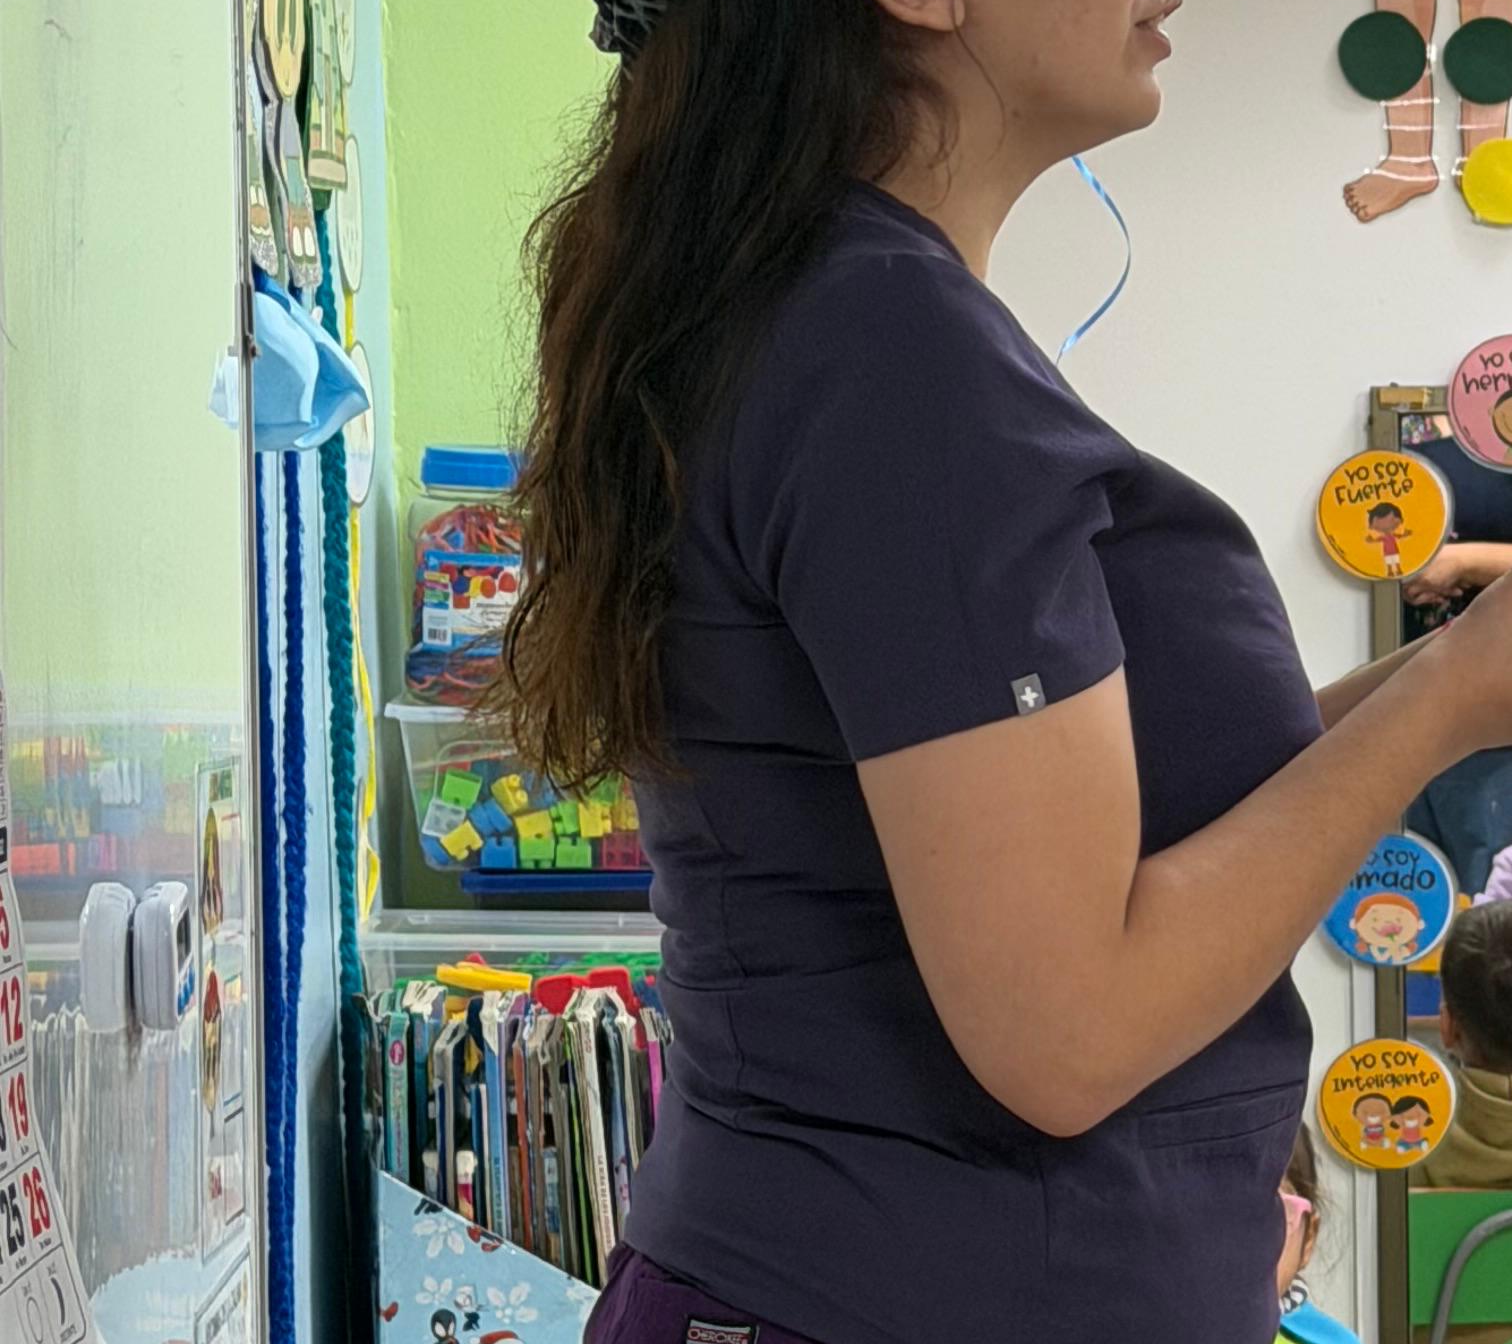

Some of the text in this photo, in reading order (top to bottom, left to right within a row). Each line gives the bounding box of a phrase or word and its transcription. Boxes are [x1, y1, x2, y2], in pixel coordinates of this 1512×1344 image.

[1373, 460, 1411, 480] SOY
[1334, 478, 1414, 506] Fuerte
[1, 975, 24, 1046] 12
[1381, 1050, 1419, 1069] SOY
[1332, 1070, 1441, 1093] Inteligente
[8, 1071, 30, 1142] 19
[0, 1166, 52, 1257] 25 26
